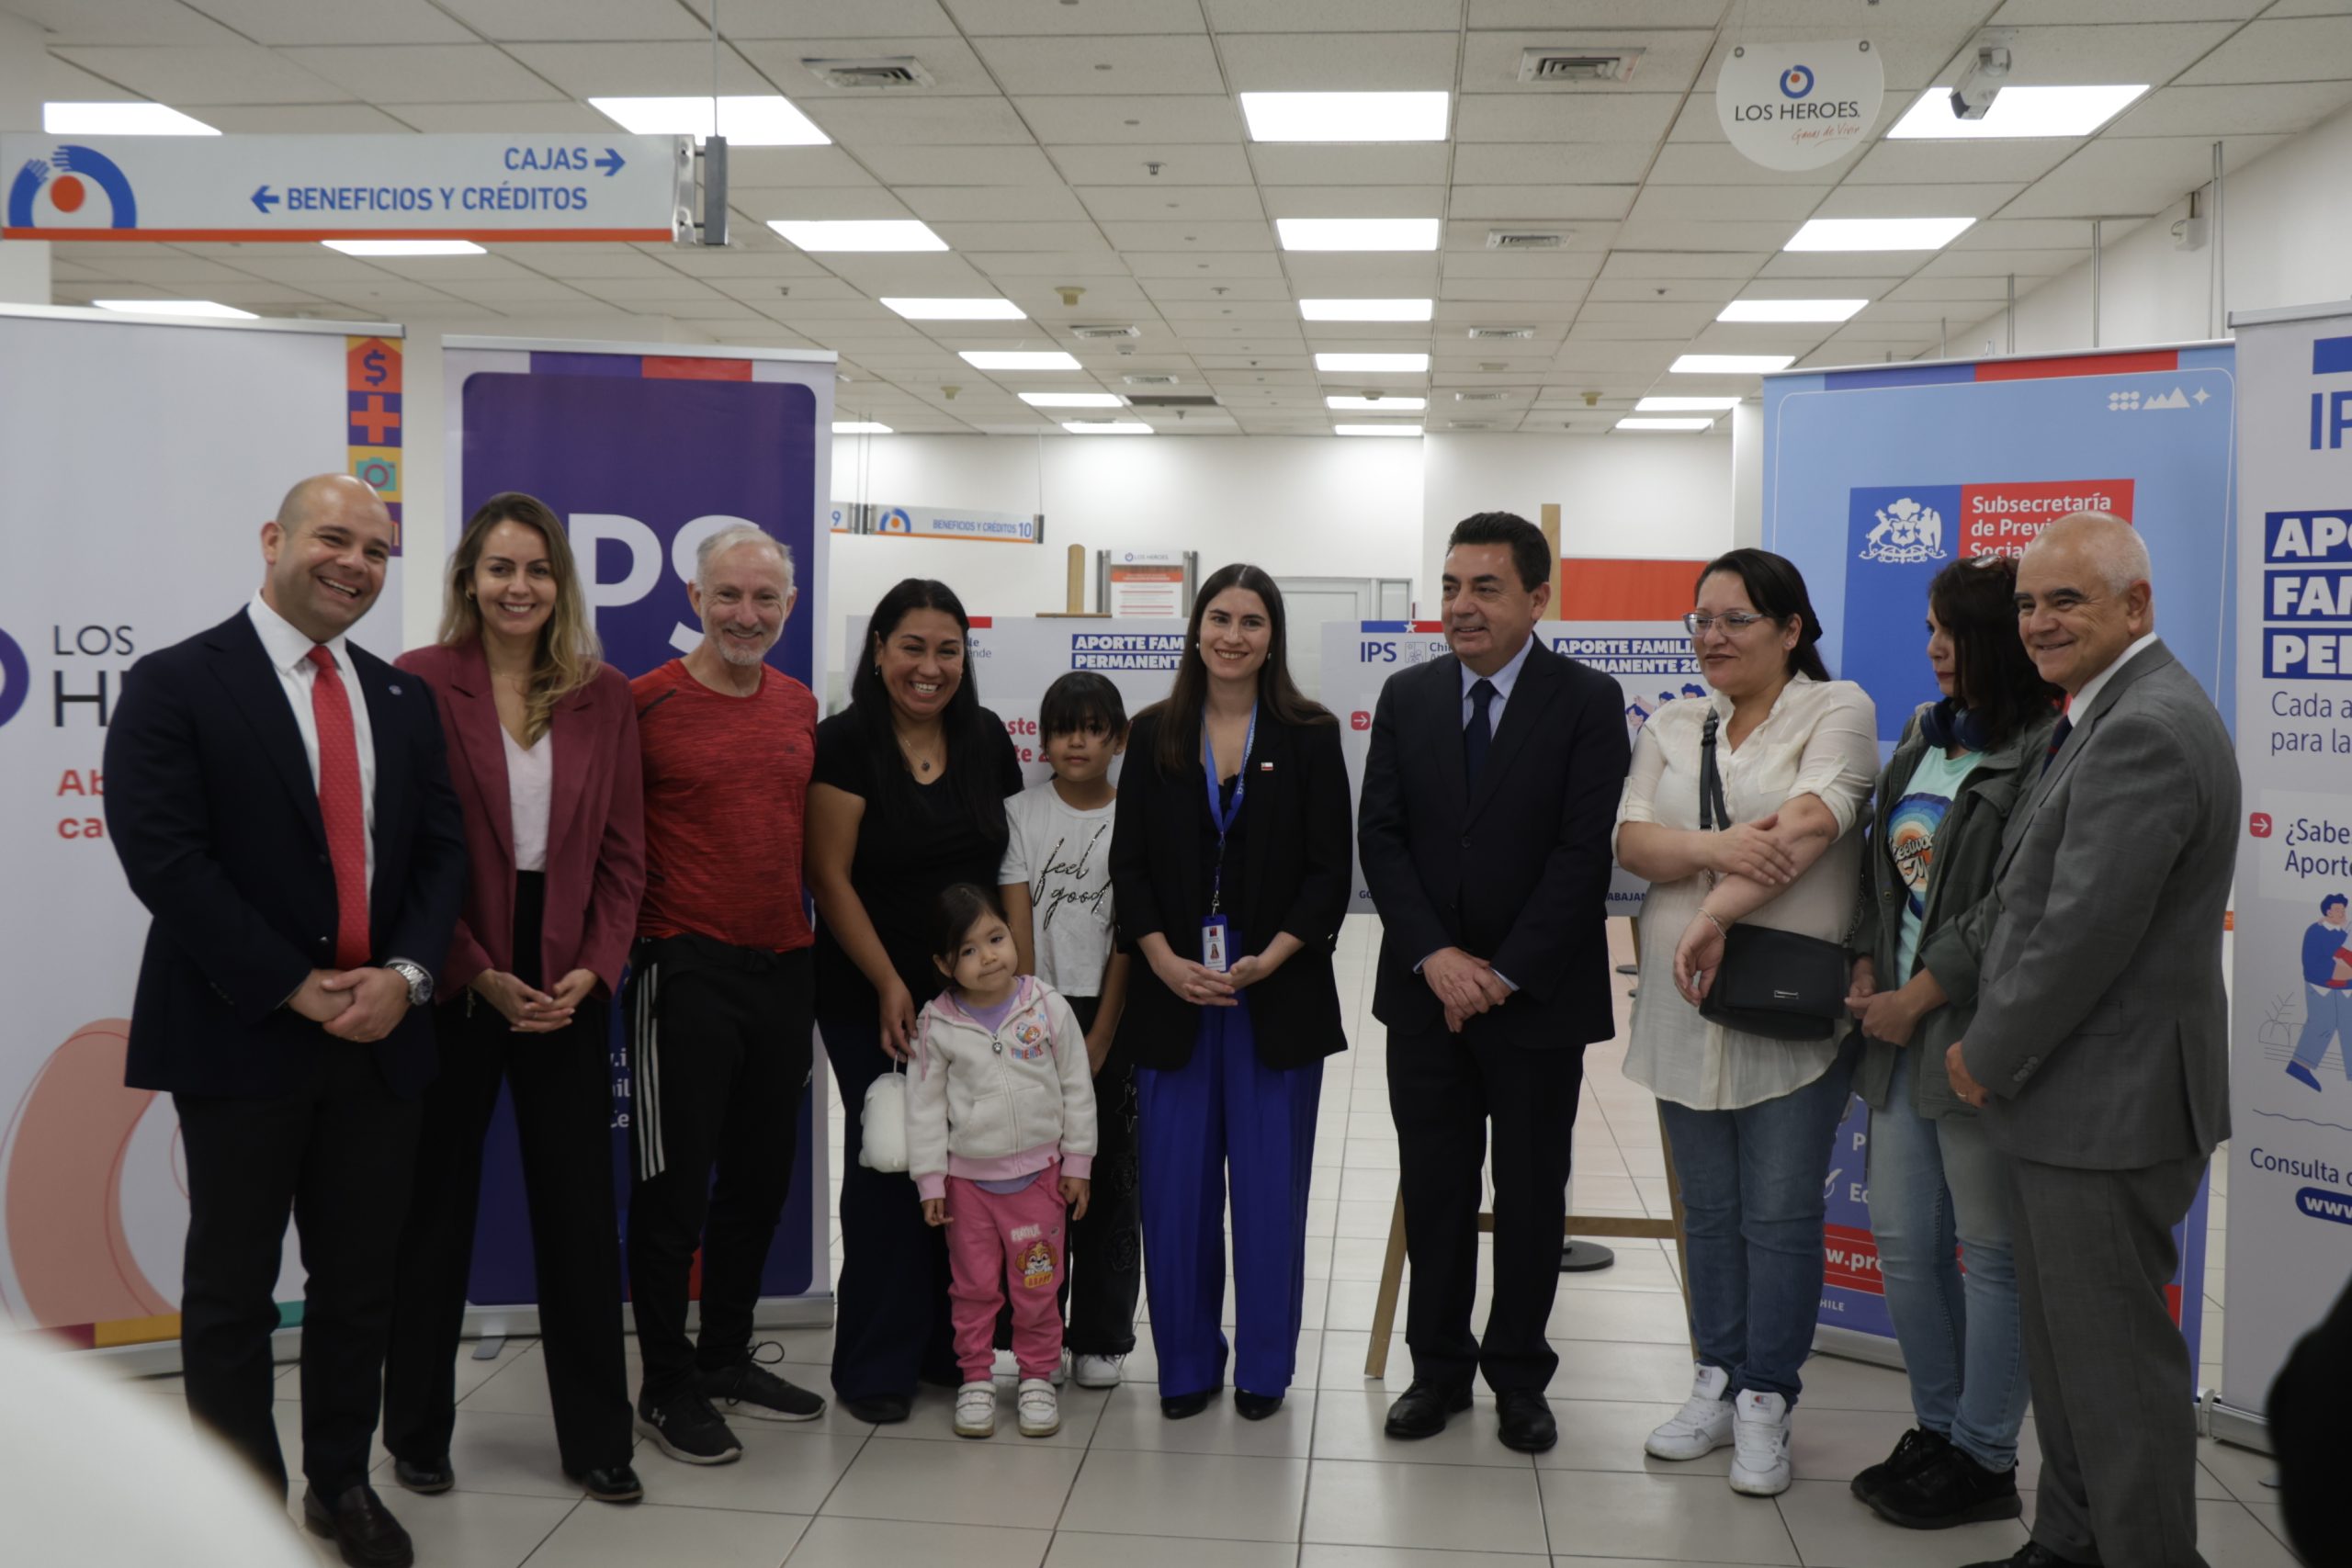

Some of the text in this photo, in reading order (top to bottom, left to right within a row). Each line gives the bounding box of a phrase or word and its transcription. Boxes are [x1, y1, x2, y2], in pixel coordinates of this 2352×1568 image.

[1735, 104, 1773, 121] LOS
[1822, 126, 1834, 138] de
[1837, 123, 1860, 135] Vivir
[504, 147, 588, 171] CAJAS
[287, 180, 588, 210] BENEFICIOS Y CRÉDITOS
[1972, 491, 2111, 513] Subsecretaría
[831, 510, 841, 527] 9
[933, 518, 1032, 538] BENEFICIOS Y CRÉDITOS 10
[1971, 519, 1995, 536] de
[2271, 515, 2352, 558] AP
[53, 625, 134, 656] LOS
[1075, 636, 1185, 650] APORTE FAM
[1361, 641, 1396, 662] IPS
[1556, 639, 1696, 654] APORTE FAMILI
[1075, 654, 1183, 669] PERMANENT
[53, 670, 130, 728] H
[2271, 691, 2332, 718] Cada
[1002, 717, 1036, 736] ste
[2271, 728, 2351, 757] para la
[1033, 824, 1107, 908] feel
[1044, 879, 1112, 931] good
[2250, 1147, 2339, 1184] Consulta
